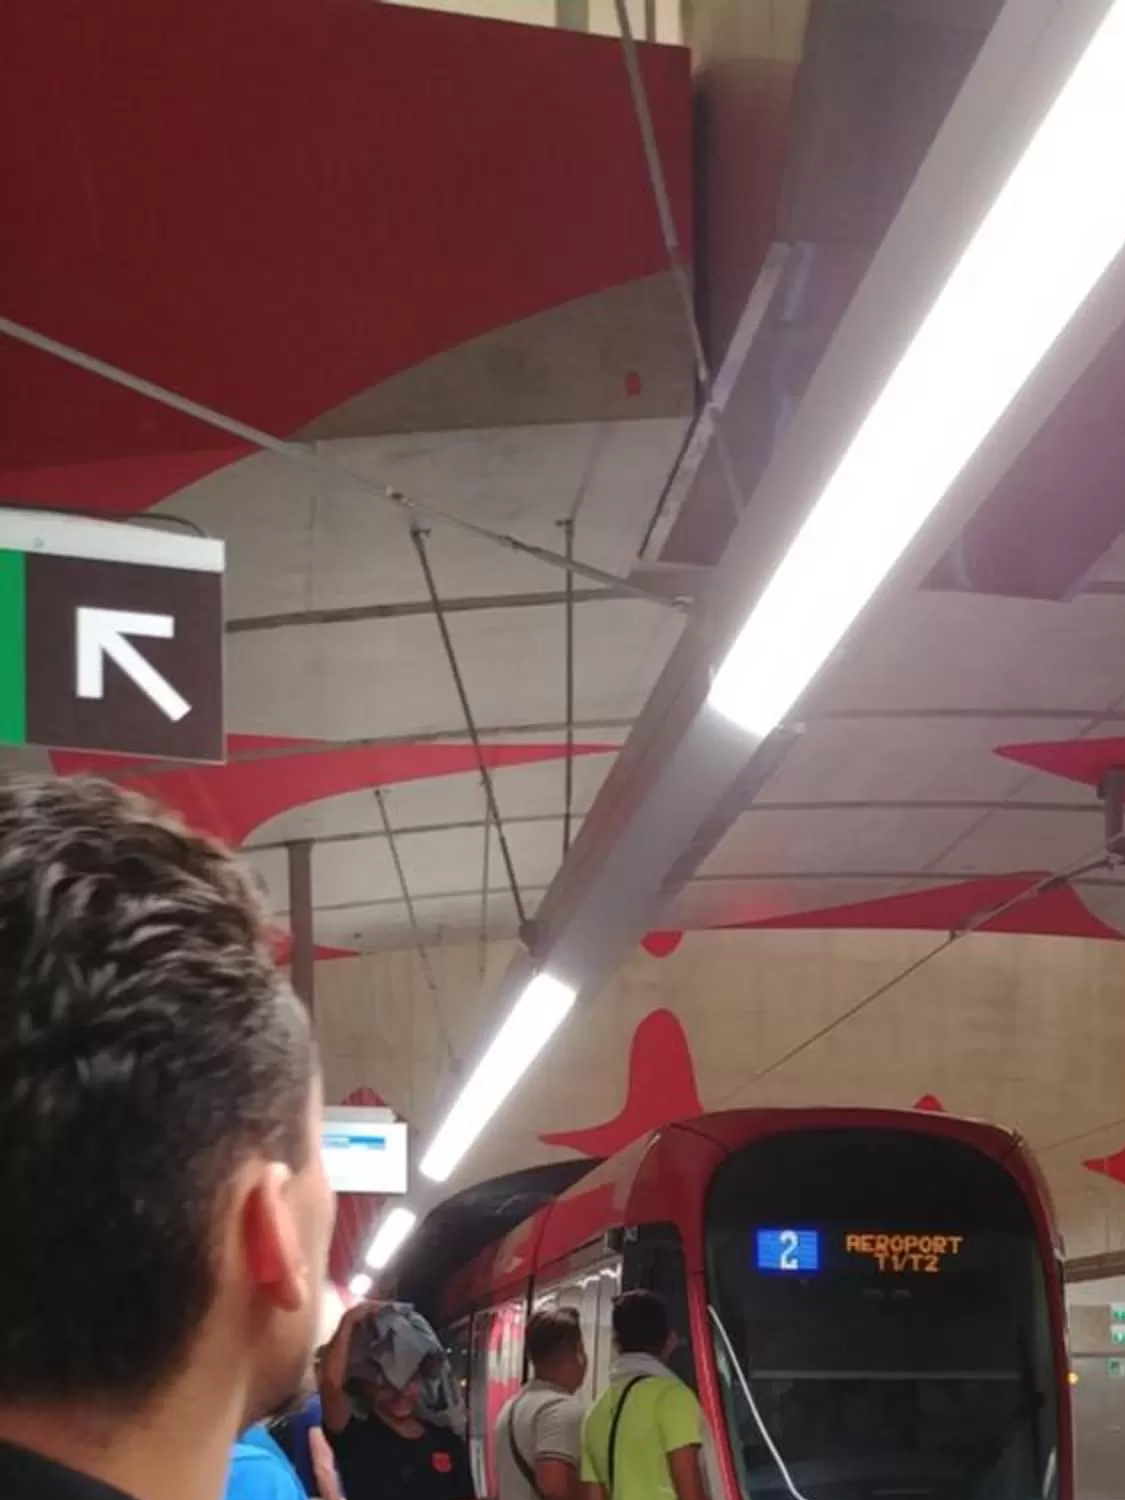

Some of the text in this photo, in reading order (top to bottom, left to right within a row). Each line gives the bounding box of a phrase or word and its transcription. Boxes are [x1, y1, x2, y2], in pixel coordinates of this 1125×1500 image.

[779, 1229, 799, 1269] 2
[845, 1234, 964, 1254] AEROPORT
[875, 1254, 940, 1272] T1/T2
